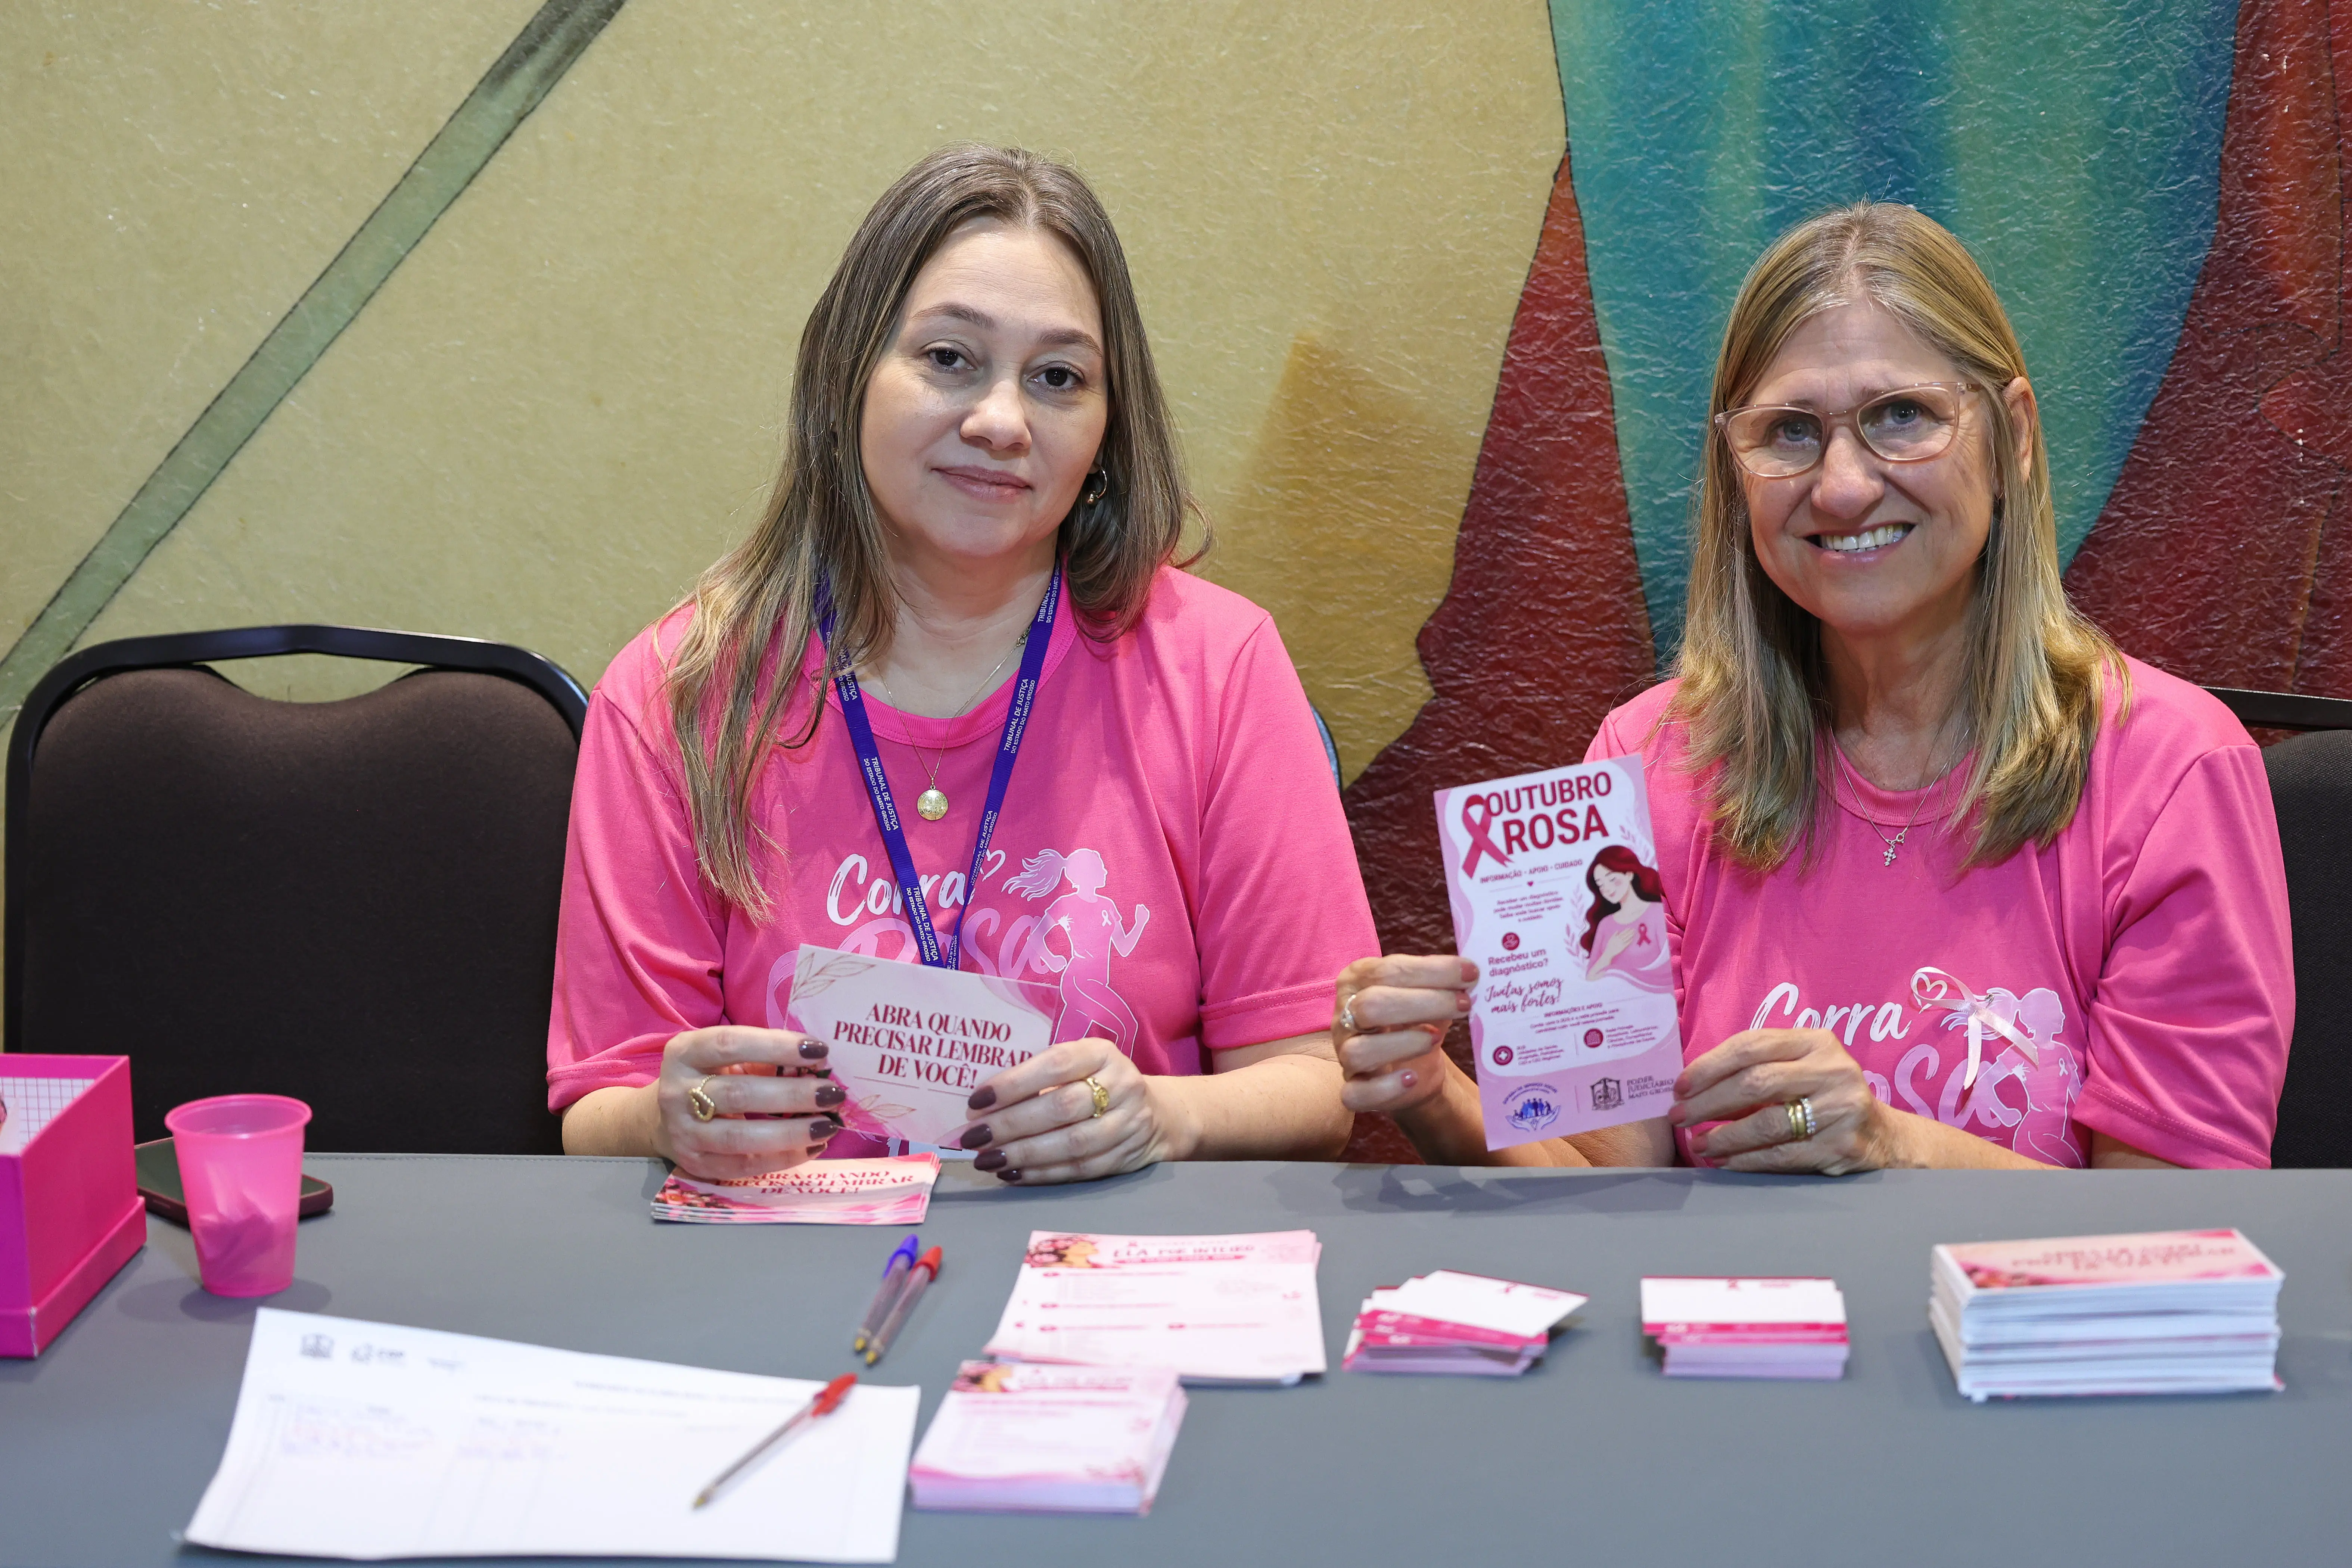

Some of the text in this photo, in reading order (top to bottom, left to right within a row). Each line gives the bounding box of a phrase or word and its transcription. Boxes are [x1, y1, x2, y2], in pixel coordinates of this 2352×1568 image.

[840, 681, 849, 701] GROSSO
[1004, 679, 1029, 752] TRIBUNAL DE JUSTIÇA
[1011, 746, 1017, 754] DO
[1014, 725, 1023, 745] ESTADO
[1020, 717, 1026, 725] DO
[1026, 679, 1036, 701] GROSSO
[864, 758, 870, 766] DO
[866, 766, 877, 786] ESTADO
[871, 756, 899, 830] TRIBUNAL DE JUSTIÇA
[875, 795, 885, 810] MATO
[1485, 771, 1612, 817] OUTUBRO
[881, 810, 891, 831] GROSSO
[979, 839, 985, 849] DE
[982, 811, 993, 839] JUSTIÇA
[1503, 804, 1609, 855] ROSA
[981, 849, 986, 858] DO
[988, 812, 998, 833] GROSSO
[1480, 859, 1583, 884] INFORMAÇÃO APOIO CUIDADO
[906, 887, 912, 896] DO
[908, 896, 918, 916] ESTADO
[913, 886, 939, 961] TRIBUNAL DE JUSTIÇA
[915, 916, 921, 924] DO
[922, 940, 931, 962] GROSSO
[1488, 949, 1547, 965] Recebeu um
[1489, 958, 1548, 977] diagnóstico?
[1484, 977, 1564, 1002] Juntas somos
[1491, 1000, 1518, 1013] mais
[865, 1002, 1011, 1042] ABRA QUANDO
[833, 1020, 933, 1056] PRECISAR
[877, 1053, 978, 1089] DE VOCÊ!
[1627, 1076, 1654, 1086] PODER
[807, 1170, 890, 1180] QUANDO
[818, 1175, 913, 1186] LEMBRAR
